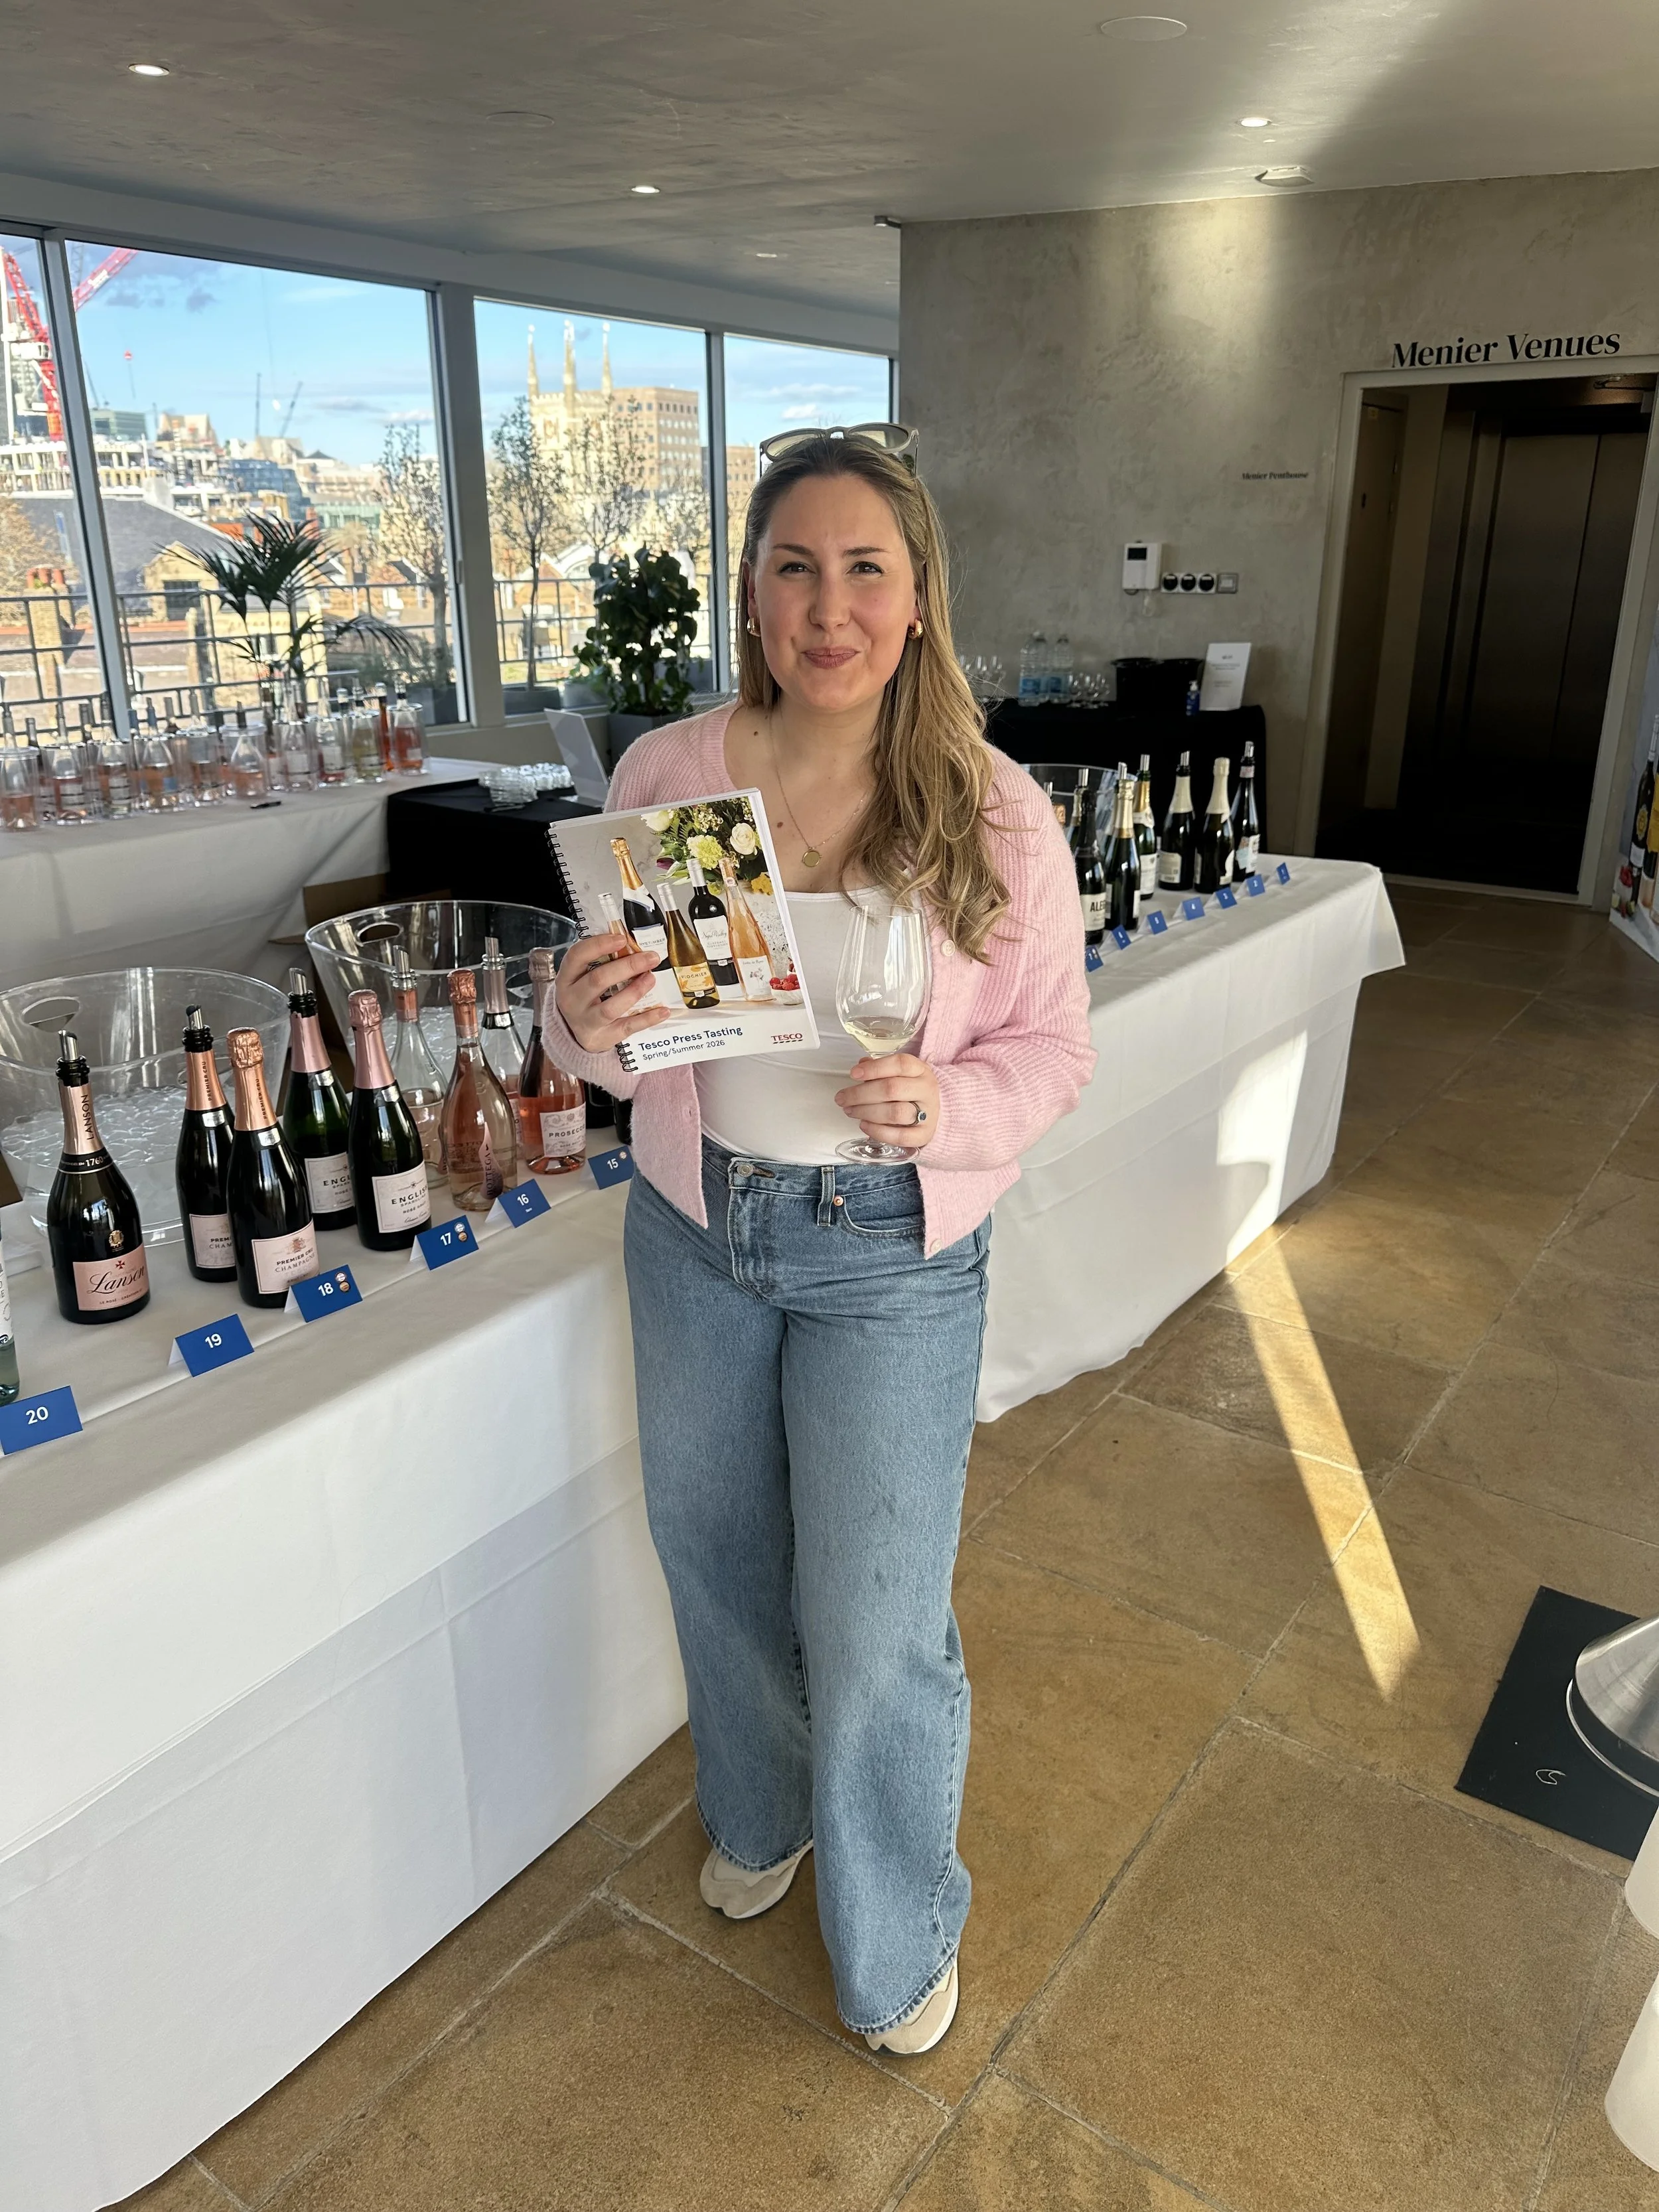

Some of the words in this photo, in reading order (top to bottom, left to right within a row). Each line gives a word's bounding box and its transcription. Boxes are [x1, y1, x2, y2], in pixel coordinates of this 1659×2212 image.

[1392, 337, 1498, 368] Menier
[1506, 333, 1621, 360] Venues
[638, 1038, 670, 1051] Tesco
[672, 1032, 702, 1045] Press
[703, 1027, 743, 1039] Tasting
[770, 1033, 803, 1042] TESCO
[642, 1043, 704, 1061] Spring/Summer
[705, 1039, 725, 1049] 2026
[204, 1074, 212, 1101] PREMIER
[258, 1092, 267, 1120] PREMIER
[80, 1094, 94, 1140] LANSON
[86, 1156, 103, 1167] 1760
[607, 1158, 618, 1169] 15
[323, 1175, 350, 1186] ENGL
[517, 1193, 529, 1206] 16
[440, 1232, 452, 1246] 17
[275, 1252, 315, 1272] CHAMPAGNE
[276, 1253, 304, 1266] PREMIER
[87, 1266, 144, 1294] Lanson
[318, 1282, 334, 1296] 18
[204, 1333, 222, 1349] 19
[25, 1406, 49, 1425] 20
